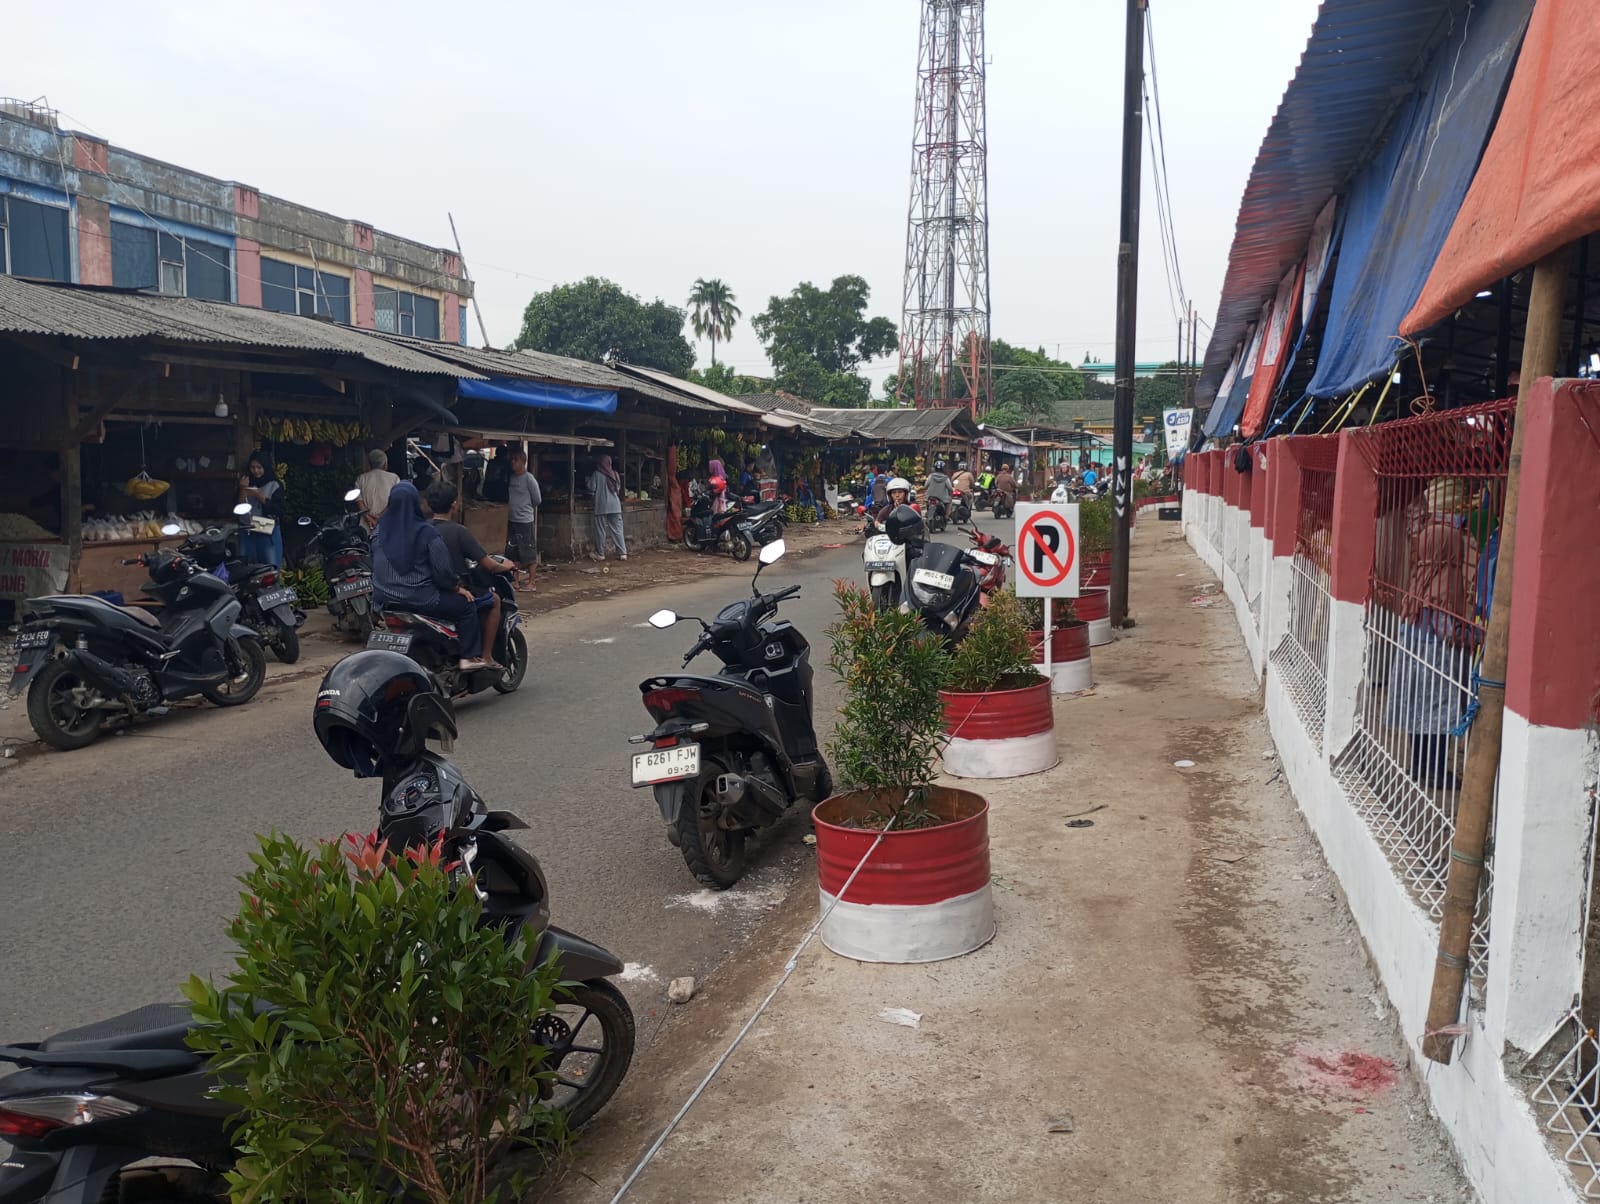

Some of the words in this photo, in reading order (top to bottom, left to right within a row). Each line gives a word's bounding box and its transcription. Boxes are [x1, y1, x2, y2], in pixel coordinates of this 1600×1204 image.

[1033, 525, 1060, 573] P
[635, 757, 641, 768] F
[647, 752, 672, 766] 6261
[677, 748, 697, 760] FJW
